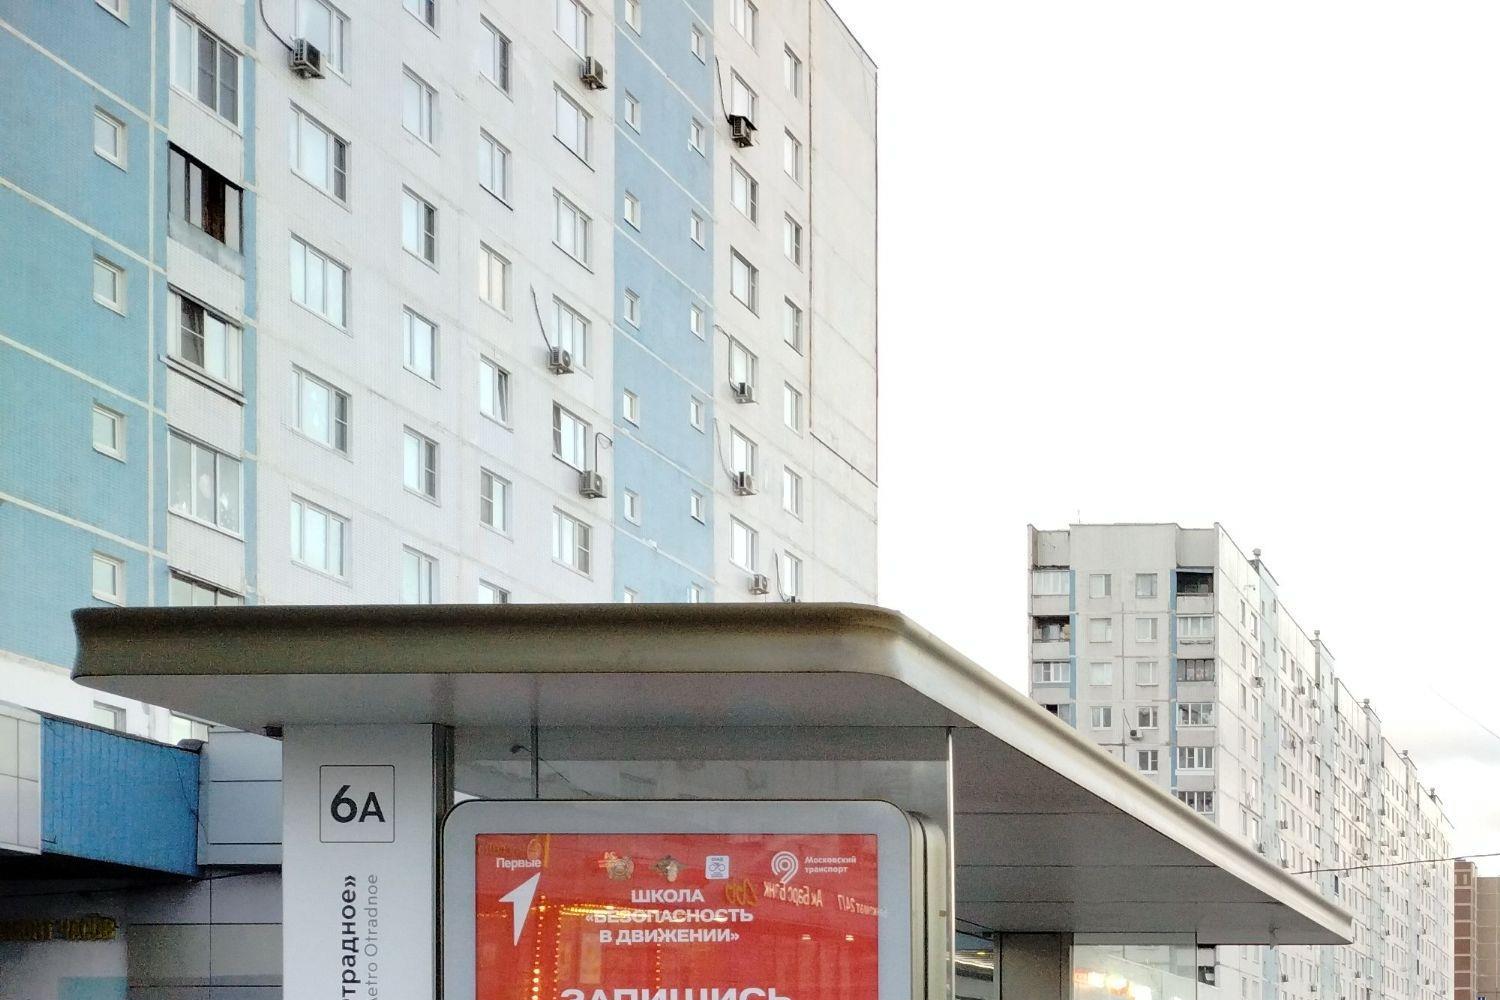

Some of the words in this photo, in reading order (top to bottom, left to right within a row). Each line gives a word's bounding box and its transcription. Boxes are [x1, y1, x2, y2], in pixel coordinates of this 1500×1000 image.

[330, 784, 386, 824] 6А
[496, 857, 542, 871] Первые
[804, 855, 859, 865] Московский
[804, 866, 848, 874] транспорт
[631, 889, 705, 903] ШКОЛА
[364, 874, 379, 957] Otradnoe
[586, 908, 754, 924] «БЕЗОПАСНОСТЬ
[600, 930, 613, 943] В
[616, 928, 740, 945] ДВИЖЕНИИ»
